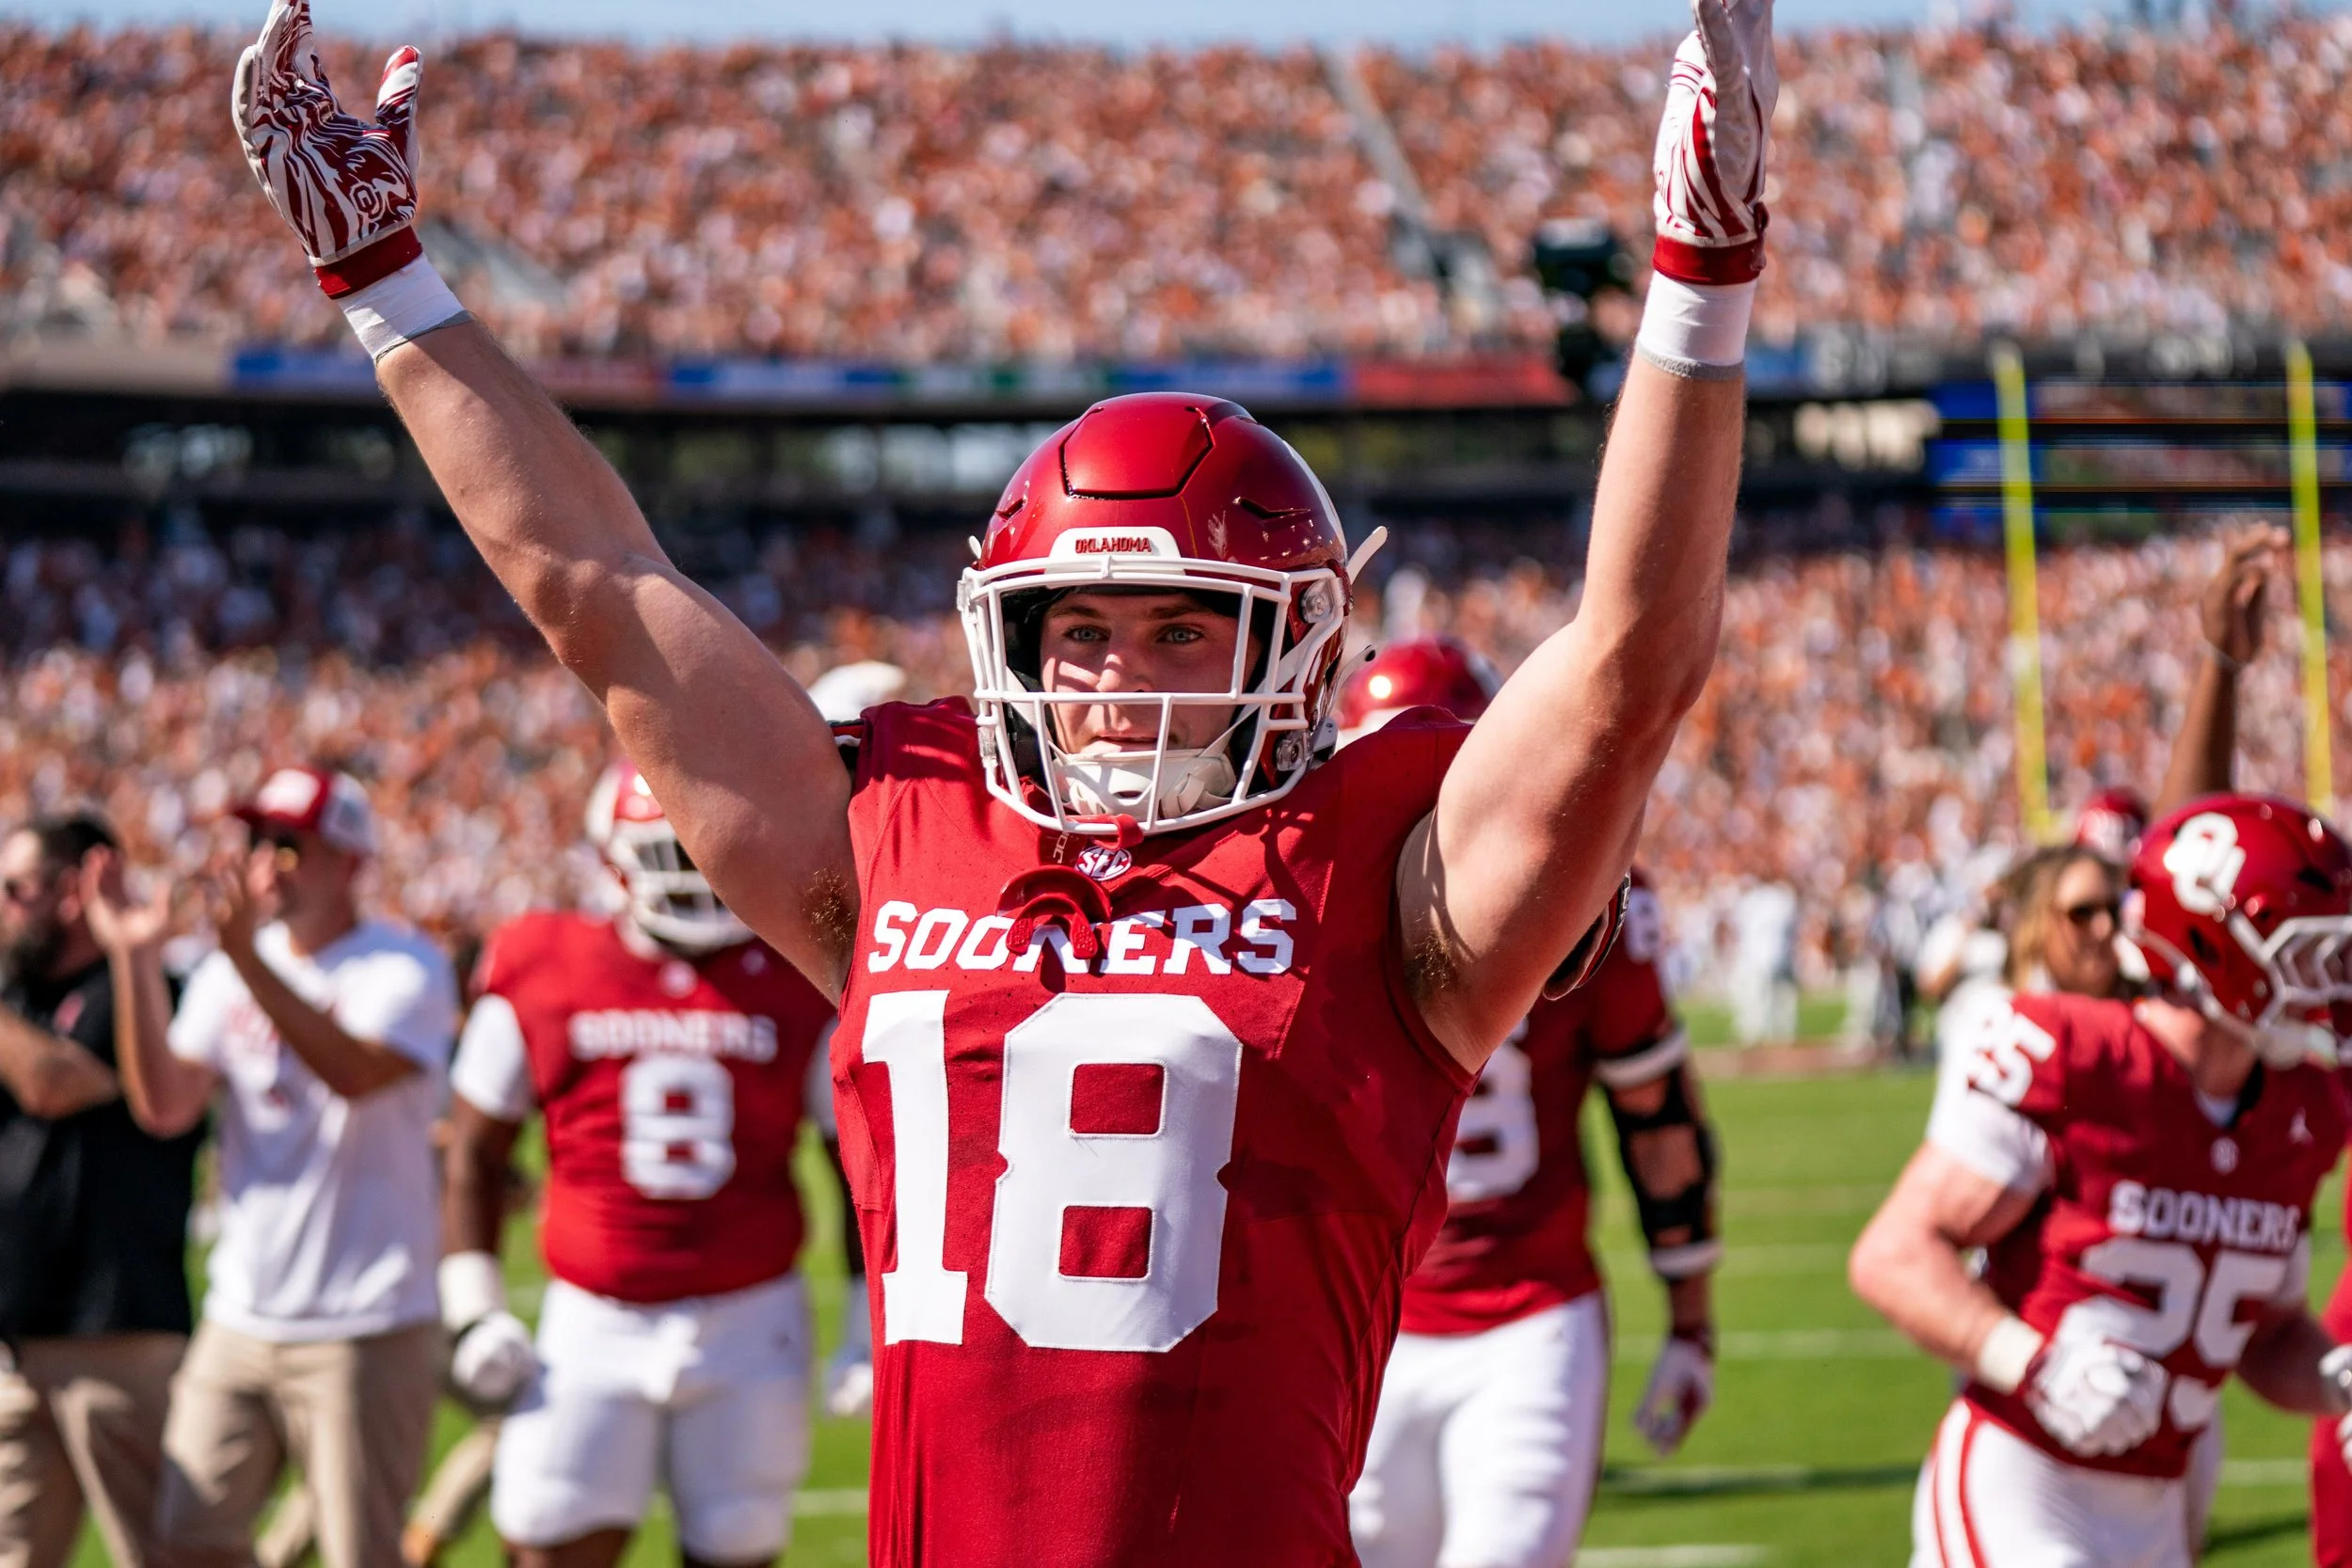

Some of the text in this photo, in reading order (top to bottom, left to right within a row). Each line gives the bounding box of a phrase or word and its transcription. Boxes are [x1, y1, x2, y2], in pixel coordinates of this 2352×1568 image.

[1074, 537, 1152, 554] OKLAHOMA
[1077, 847, 1130, 879] SEC
[618, 1053, 737, 1201] 8
[862, 990, 1243, 1353] 18
[2108, 1180, 2302, 1251] SOONERS
[2079, 1237, 2288, 1432] 25
